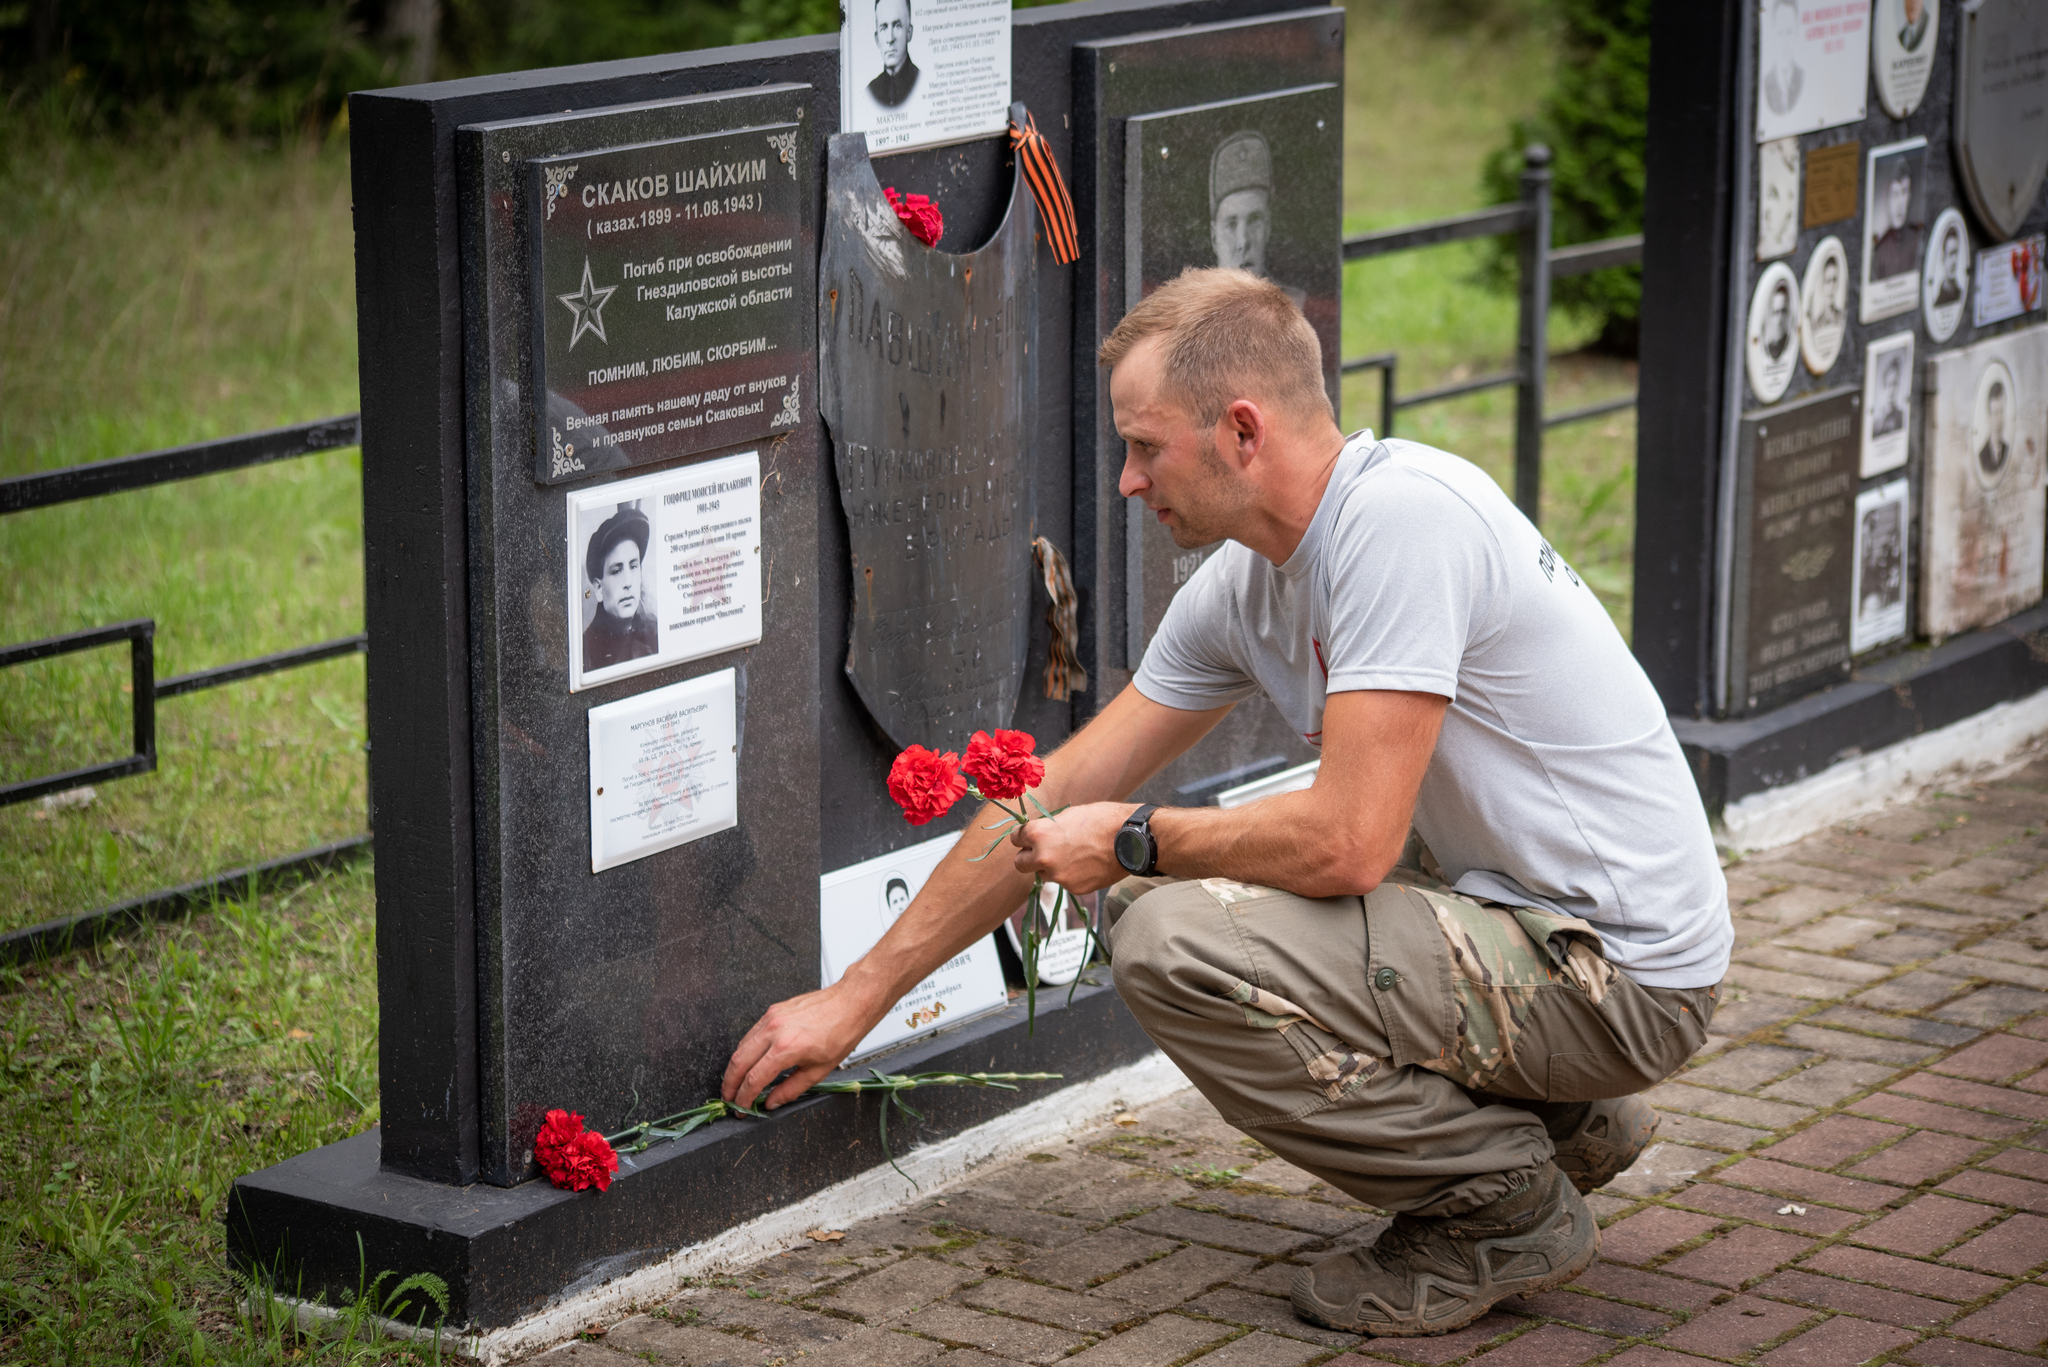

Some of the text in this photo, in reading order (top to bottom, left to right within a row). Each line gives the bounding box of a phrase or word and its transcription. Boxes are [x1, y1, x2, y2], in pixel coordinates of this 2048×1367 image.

[928, 38, 941, 46] Дата
[876, 112, 908, 125] МАКУРИН
[875, 136, 889, 147] 1897
[896, 133, 909, 143] 1943
[582, 159, 766, 208] СКАКОВ ШАЙХИМ
[587, 219, 592, 239] (
[596, 208, 671, 235] казах.1899
[684, 194, 753, 219] 11.08.1943
[757, 193, 762, 211] )
[623, 238, 792, 279] Погиб при освобождении
[637, 262, 792, 301] Гнездиловской высоты
[666, 286, 792, 322] Калужской области
[588, 337, 777, 385] ПОМНИМ, ЛЮБИМ, СКОРБИМ...
[566, 375, 787, 431] Вечная память нашему деду от внуков
[592, 399, 764, 448] и правнуков семьи Скаковых!
[664, 476, 752, 505] ГОЦФРИД МОИСЕЙ ИСААКОВИЧ
[697, 500, 720, 514] 1901-1943
[664, 533, 684, 543] Стрелок
[688, 529, 700, 538] роты
[709, 520, 737, 533] стрелкового
[738, 517, 752, 525] полка
[678, 539, 704, 552] стрелковой
[673, 563, 688, 572] Погиб
[693, 559, 703, 567] бою
[729, 550, 741, 559] 1943
[683, 582, 732, 599] Смоленской области
[683, 605, 700, 615] Найден
[630, 704, 708, 732] МАРГУНОВ ВАСИЛИЙ ВАСИЛЬЕВИЧ
[905, 994, 932, 1008] смертью
[935, 983, 962, 999] храбрых
